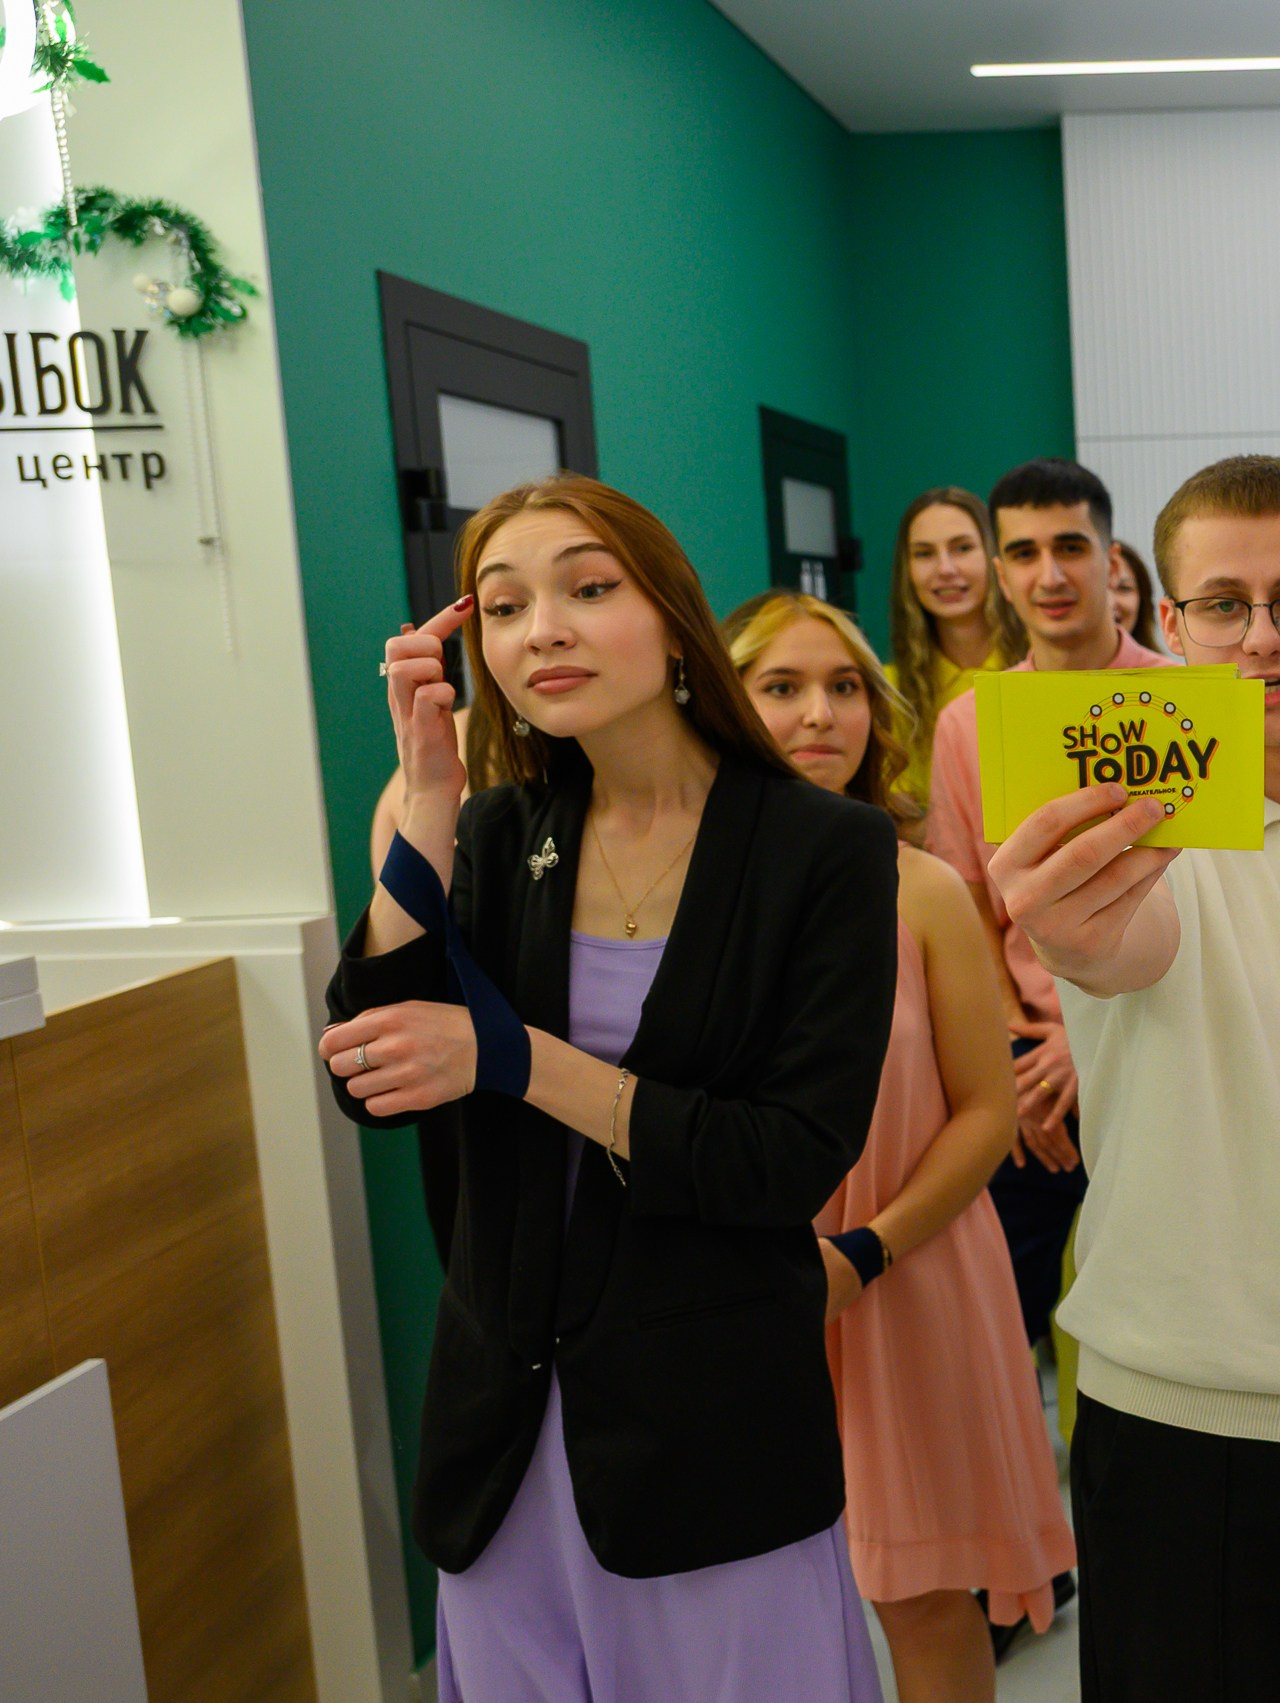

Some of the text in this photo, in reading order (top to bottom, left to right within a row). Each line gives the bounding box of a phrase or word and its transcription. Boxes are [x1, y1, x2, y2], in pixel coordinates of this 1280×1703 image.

[17, 451, 167, 490] центр
[1062, 719, 1148, 755] SHOW
[1066, 737, 1220, 788] TODAY
[1129, 787, 1177, 796] ЛЕКАТЕЛЬНОЕ
